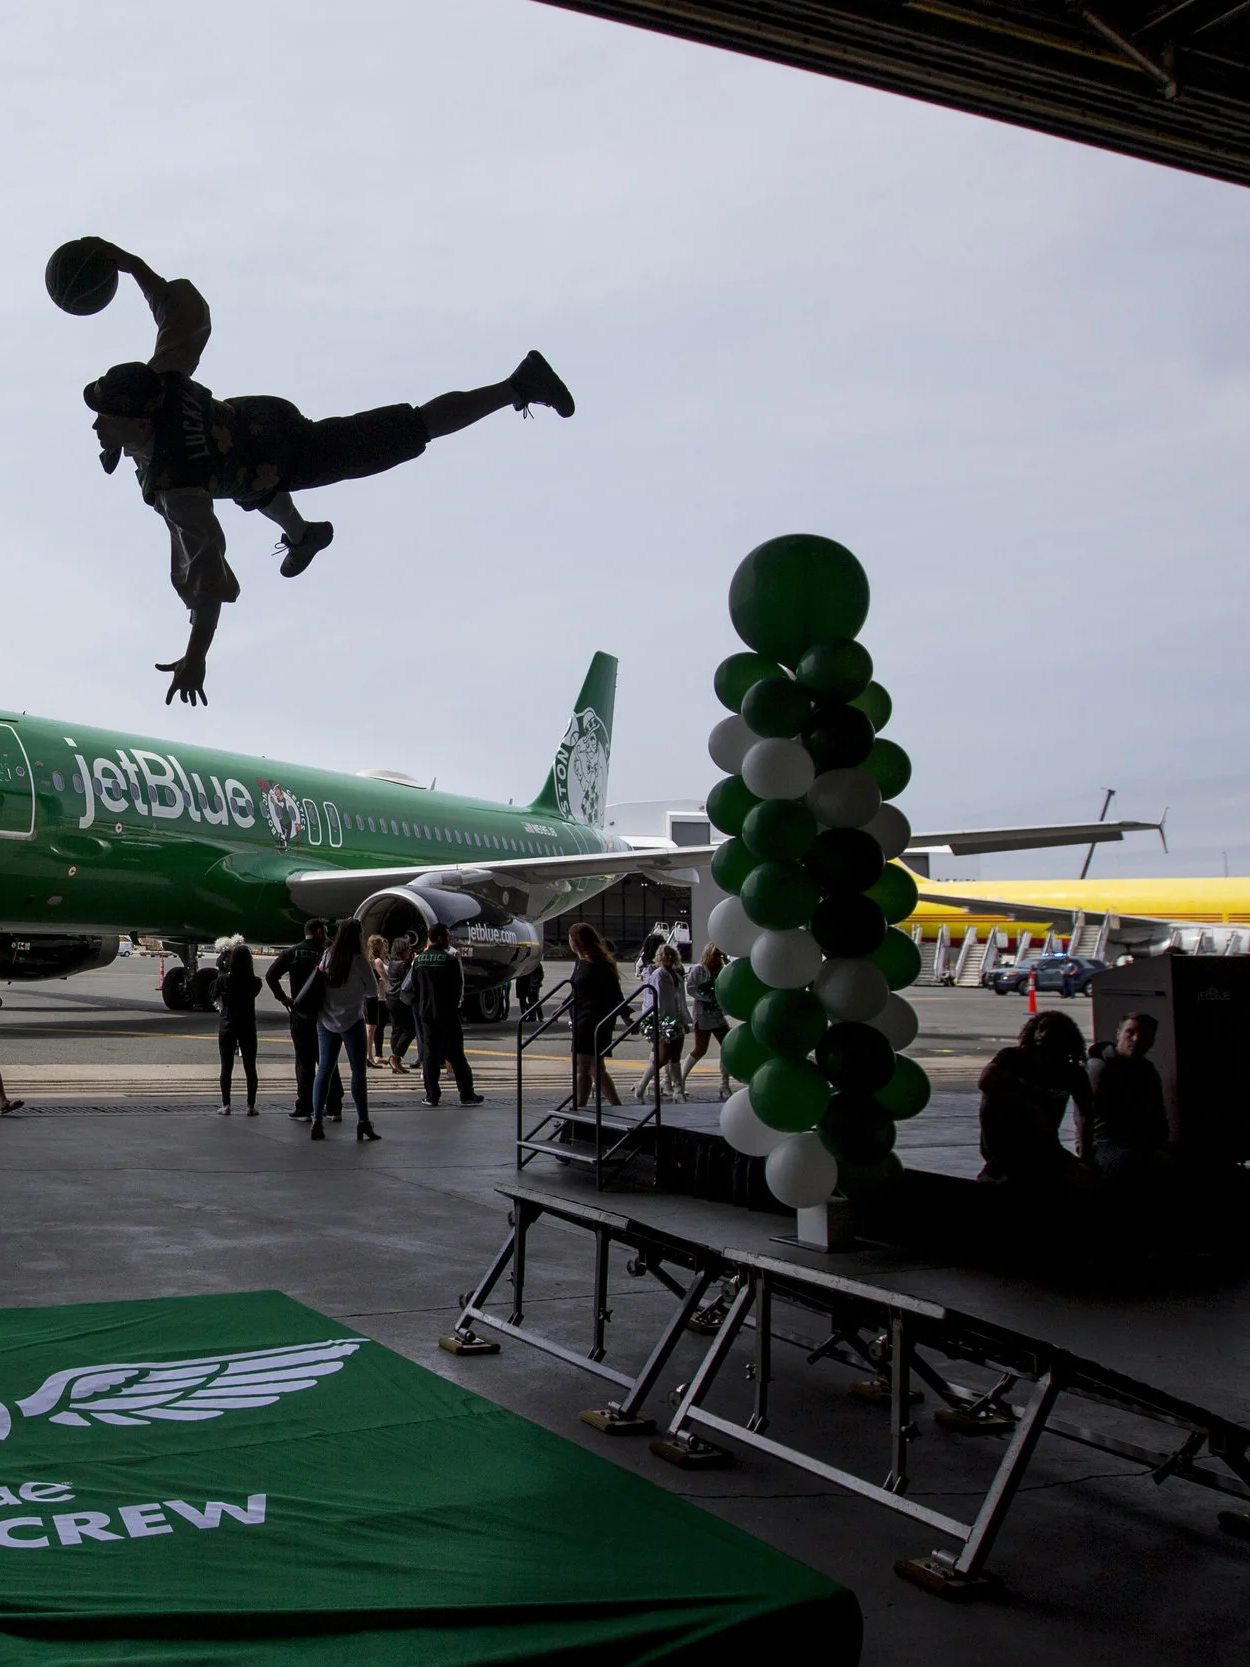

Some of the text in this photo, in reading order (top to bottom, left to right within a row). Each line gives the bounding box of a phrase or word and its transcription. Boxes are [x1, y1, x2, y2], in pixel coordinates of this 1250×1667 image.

[182, 391, 210, 460] LUCKY
[63, 737, 255, 829] jetBlue
[556, 746, 570, 813] STON
[417, 953, 447, 962] CELTICS
[466, 921, 518, 945] jetblue.com
